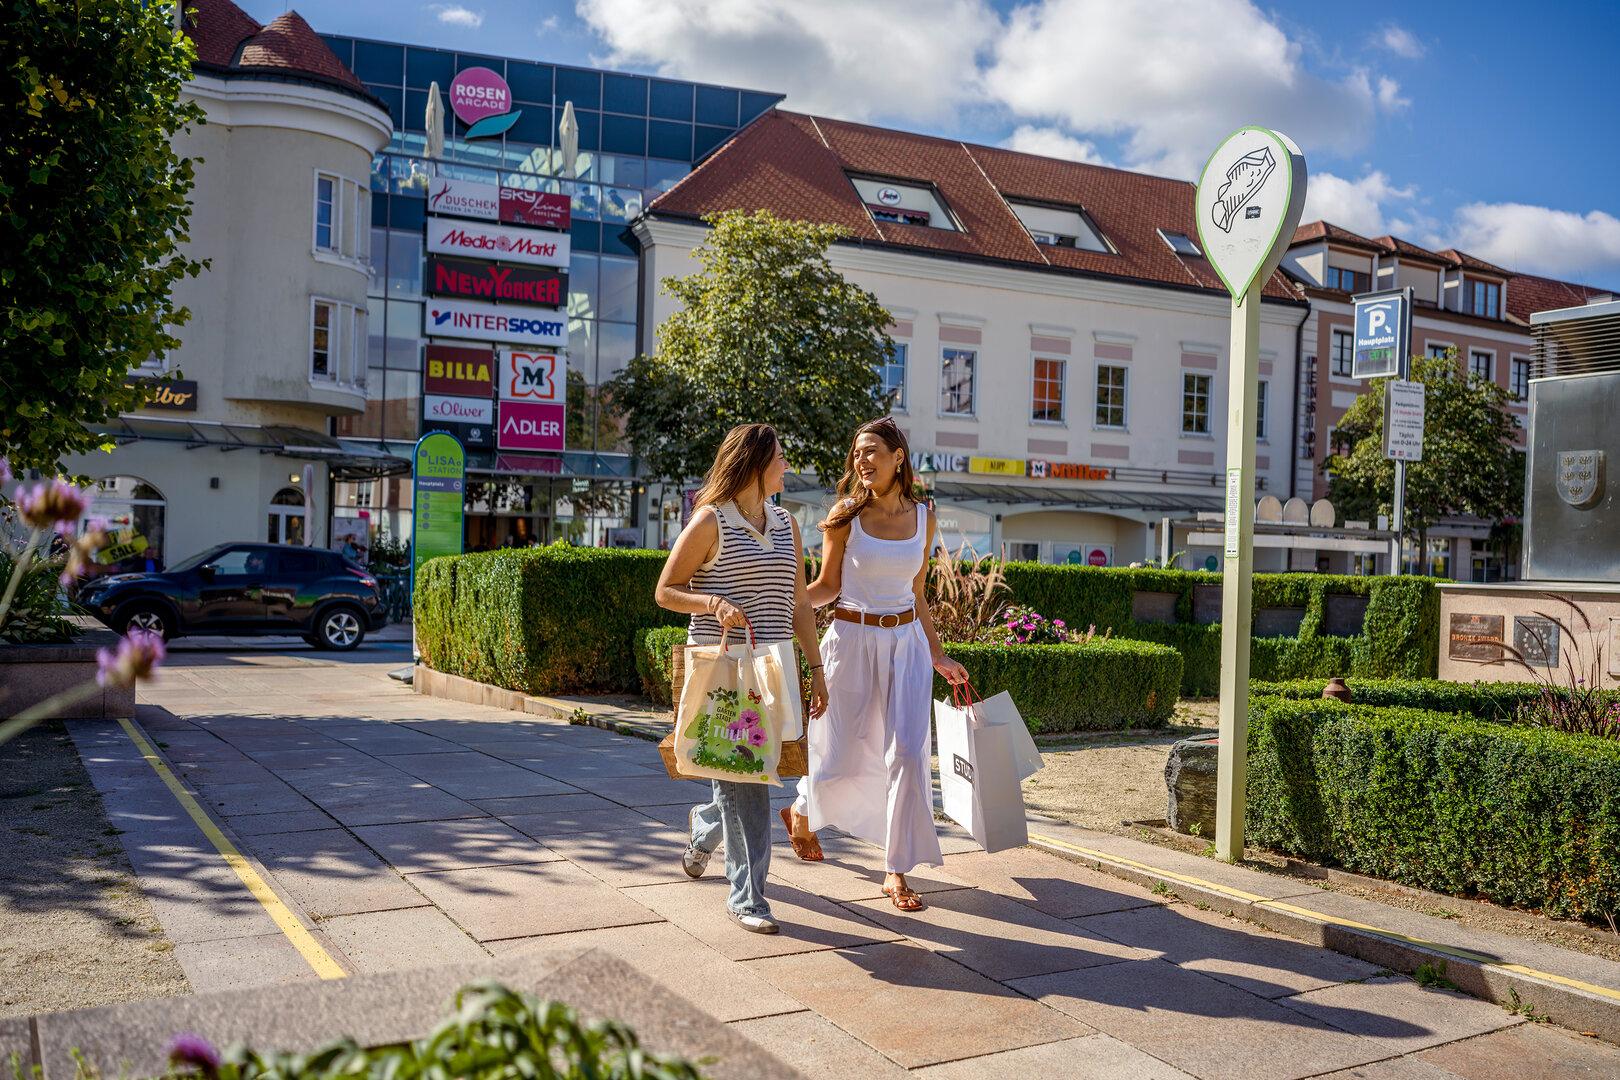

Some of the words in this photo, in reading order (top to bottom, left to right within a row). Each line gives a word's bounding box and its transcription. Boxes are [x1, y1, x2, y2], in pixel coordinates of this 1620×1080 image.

[456, 84, 506, 101] ROSEN
[456, 97, 505, 110] ARCADE
[445, 195, 497, 210] DUSCHEK
[500, 188, 536, 203] SKY
[441, 229, 496, 250] Media
[509, 238, 557, 257] Markt
[453, 311, 563, 336] INTERSPORT
[1368, 310, 1386, 337] P
[1358, 335, 1395, 347] Hauptplatz
[429, 360, 491, 382] BILLA
[521, 366, 545, 387] M
[432, 400, 484, 418] s.Oliver
[1304, 355, 1318, 458] PENSION
[503, 415, 560, 437] ADLER
[428, 466, 462, 475] STATION
[1050, 462, 1109, 481] Müller
[109, 543, 137, 560] SALE
[715, 713, 731, 723] STADT
[716, 706, 737, 718] GARTEN
[713, 725, 749, 742] TULLN
